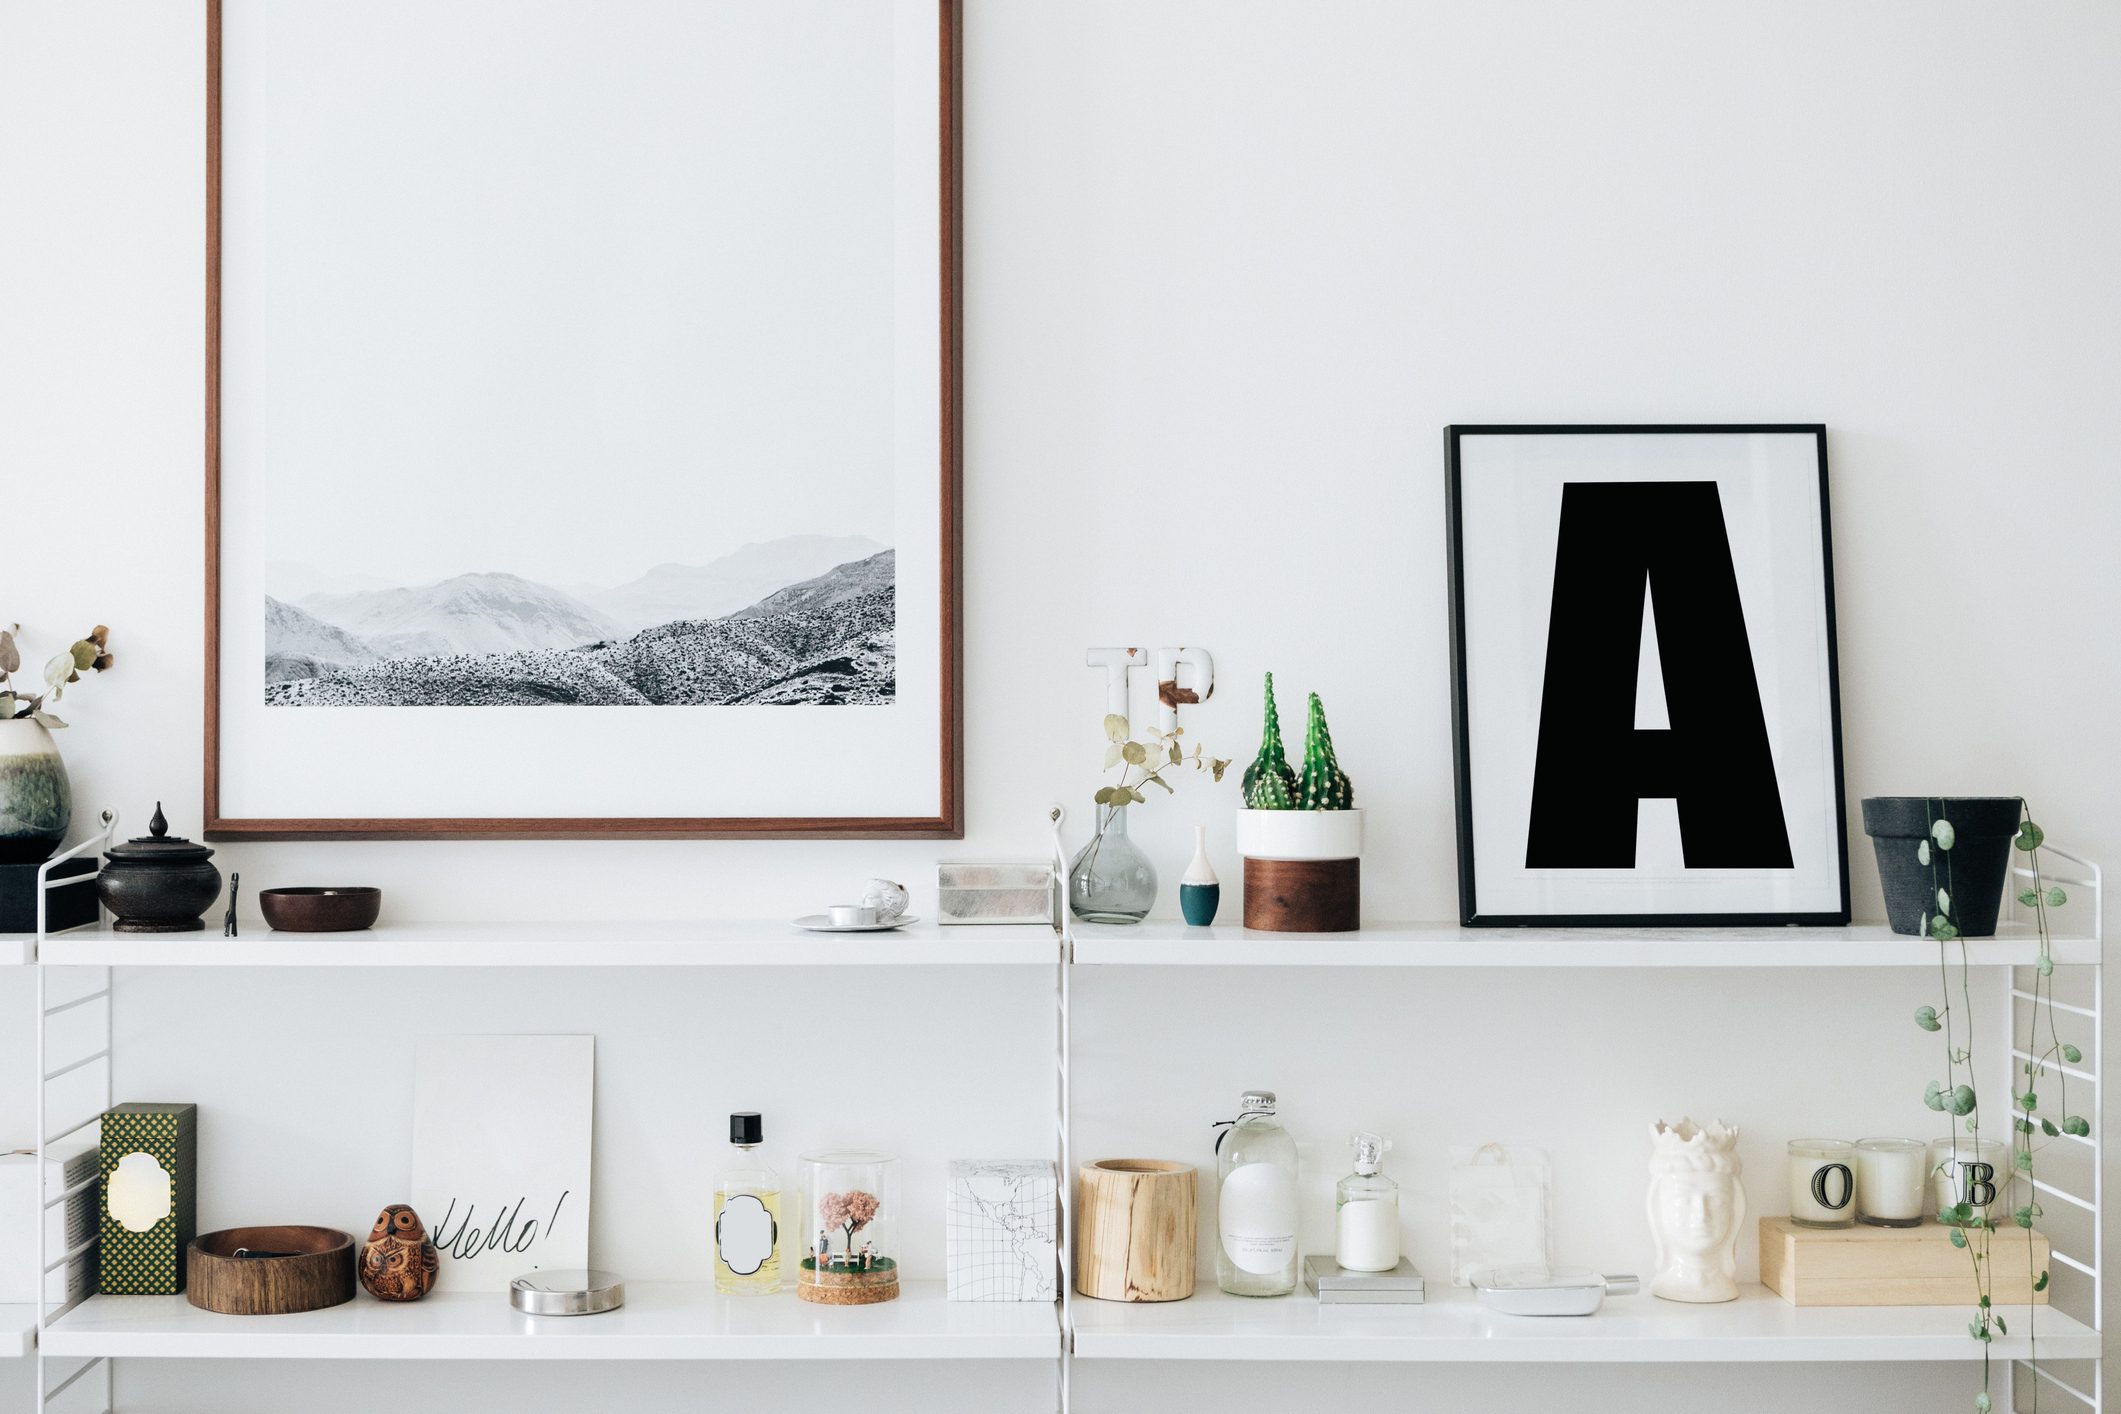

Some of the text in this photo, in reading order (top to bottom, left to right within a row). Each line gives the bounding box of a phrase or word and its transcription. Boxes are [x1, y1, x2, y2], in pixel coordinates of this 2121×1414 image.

[1525, 481, 1795, 869] A
[1811, 1163, 1854, 1210] O
[1957, 1161, 1996, 1207] B
[433, 1190, 570, 1269] Hello!
